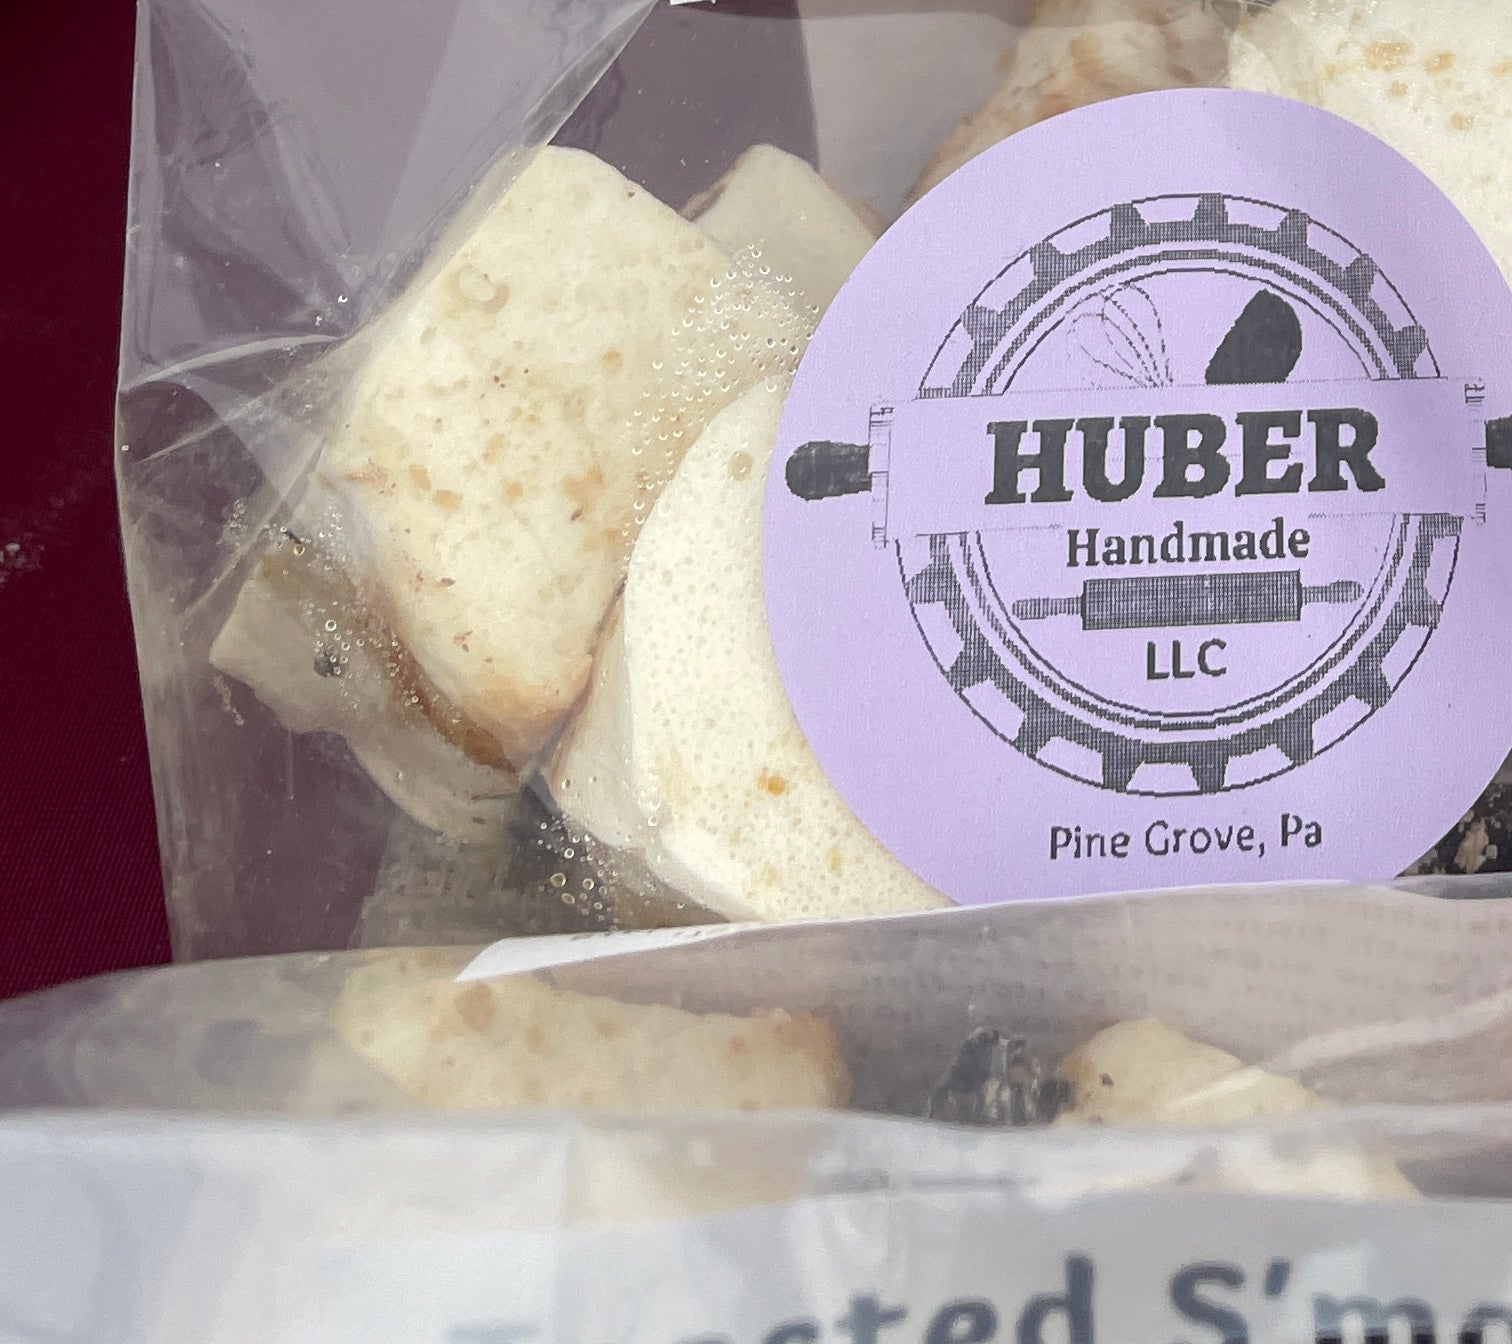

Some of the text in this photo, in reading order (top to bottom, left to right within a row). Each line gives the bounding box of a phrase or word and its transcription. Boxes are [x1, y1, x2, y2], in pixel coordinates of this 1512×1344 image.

[984, 407, 1386, 506] HUBER
[1065, 518, 1311, 568] Handmade
[1145, 638, 1228, 681] LLC
[1050, 813, 1322, 861] Pine Grove, Pa
